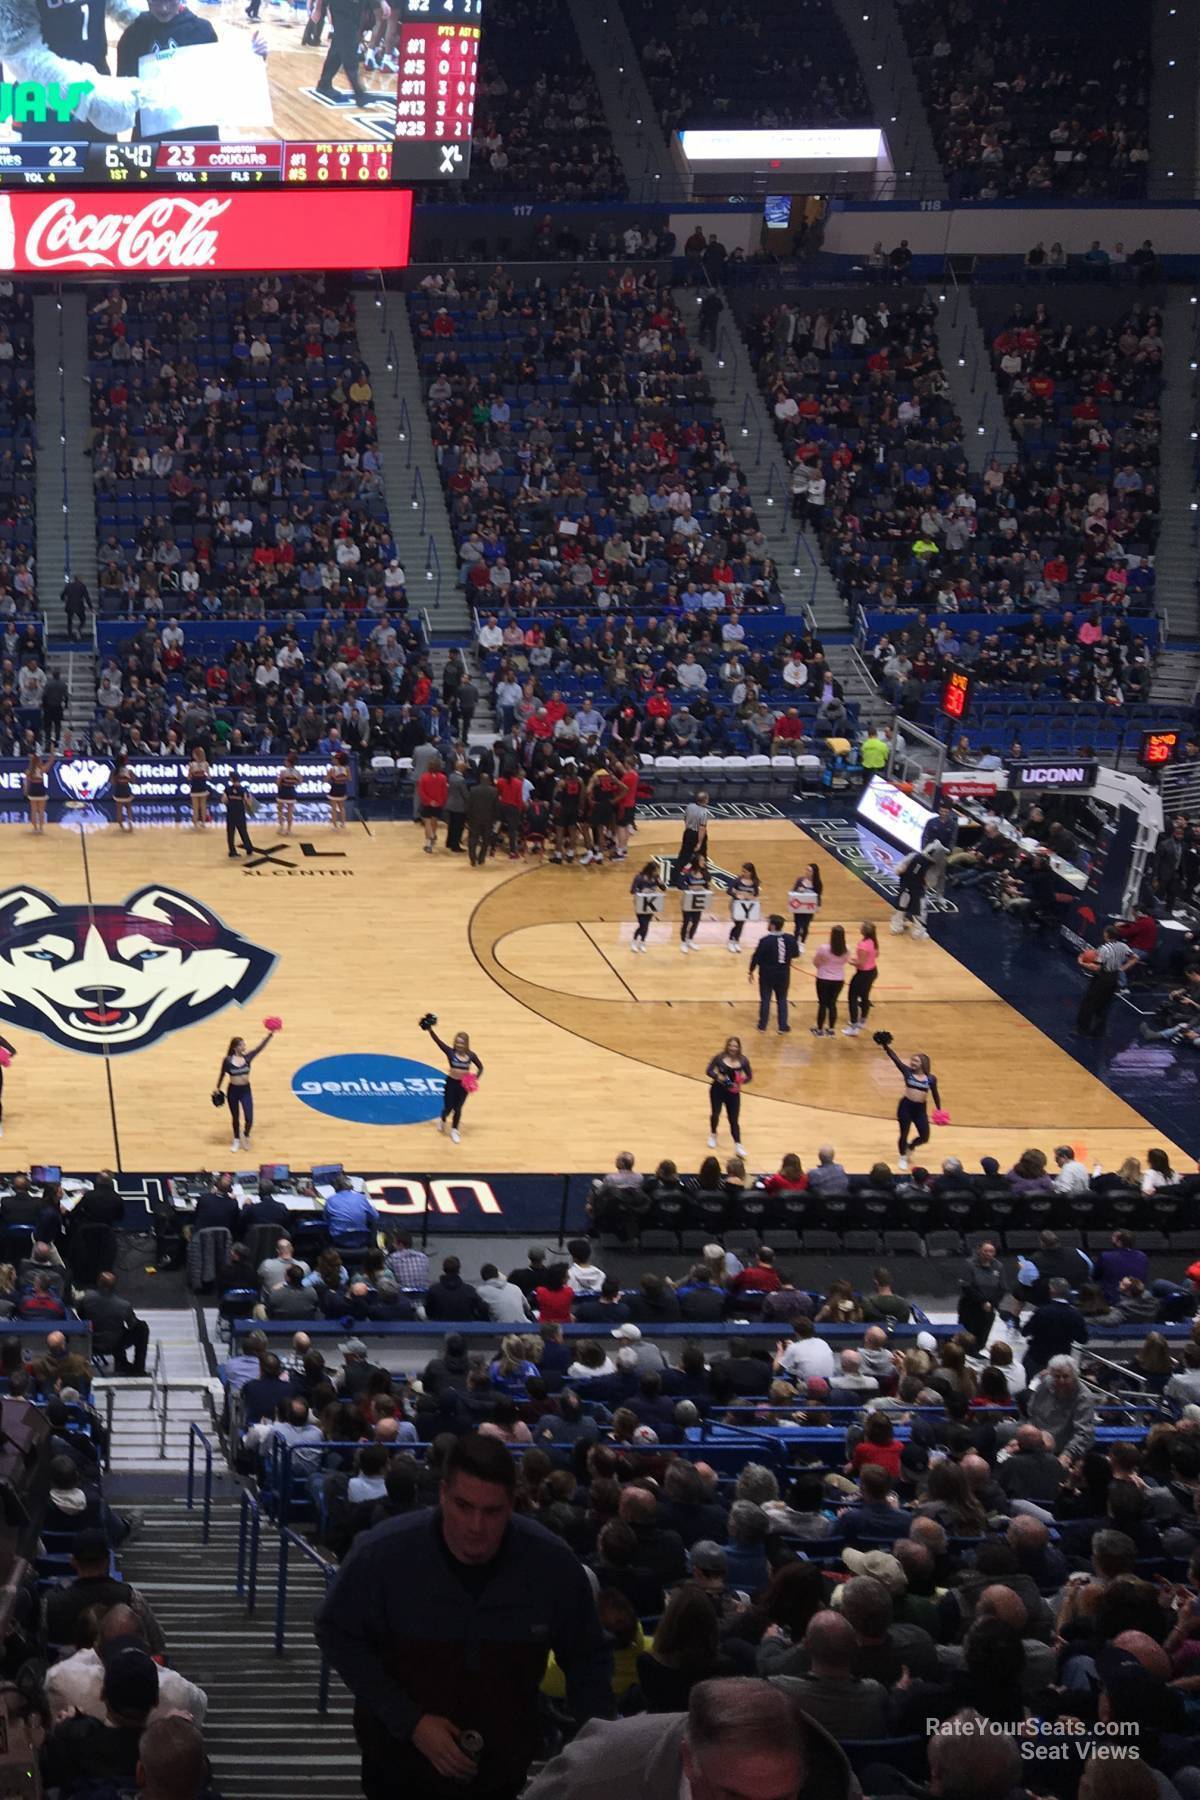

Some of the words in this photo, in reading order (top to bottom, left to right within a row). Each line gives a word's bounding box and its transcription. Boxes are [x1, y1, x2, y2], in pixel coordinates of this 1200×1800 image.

[48, 146, 77, 167] 22
[105, 145, 151, 167] 6:40
[167, 146, 196, 166] 23
[208, 154, 267, 165] COUGARS
[110, 169, 128, 180] 1ST
[1022, 768, 1085, 783] UCONN
[238, 843, 347, 868] XL
[642, 896, 657, 912] K
[693, 894, 706, 909] E
[741, 903, 755, 919] Y
